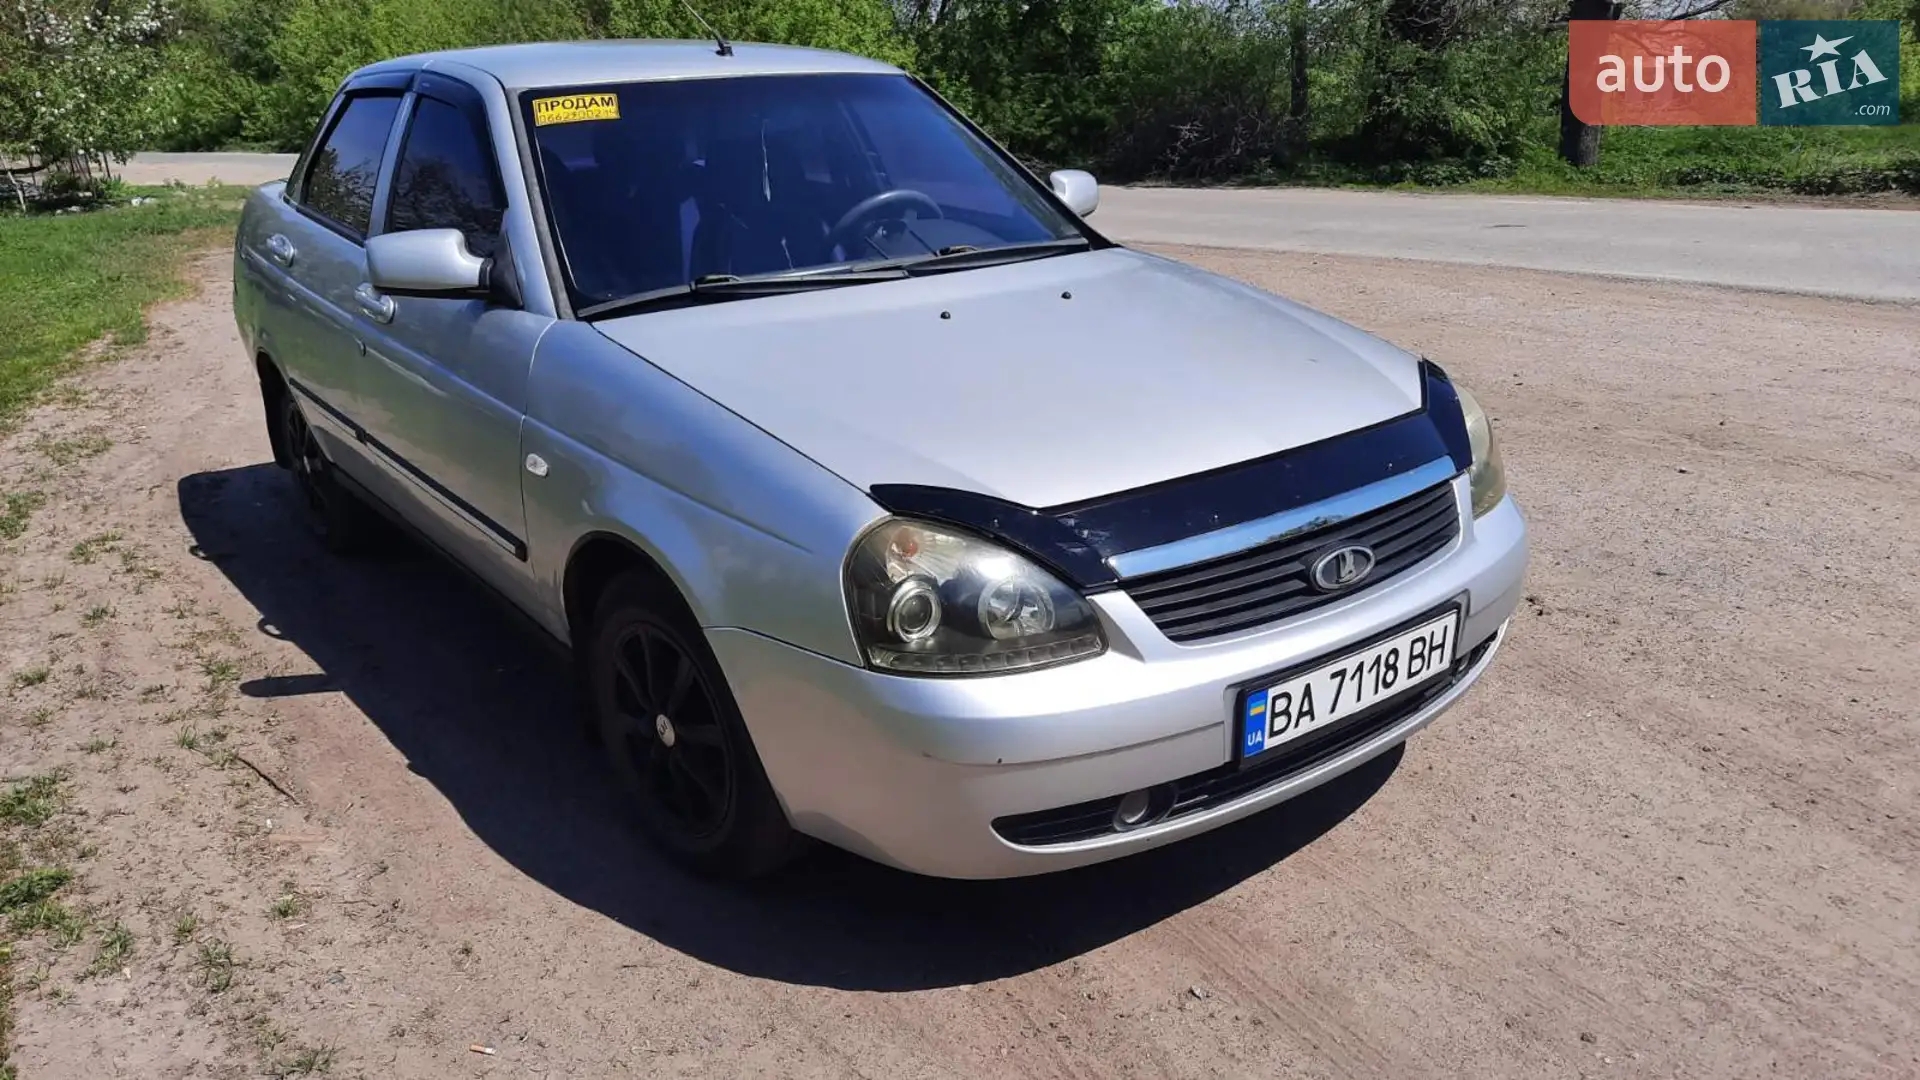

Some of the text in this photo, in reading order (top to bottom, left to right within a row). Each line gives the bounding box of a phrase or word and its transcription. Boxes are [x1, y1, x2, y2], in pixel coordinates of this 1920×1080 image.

[537, 96, 614, 113] ПРОДАМ
[1268, 624, 1448, 739] BA 7118 BH
[1247, 730, 1263, 747] UA
